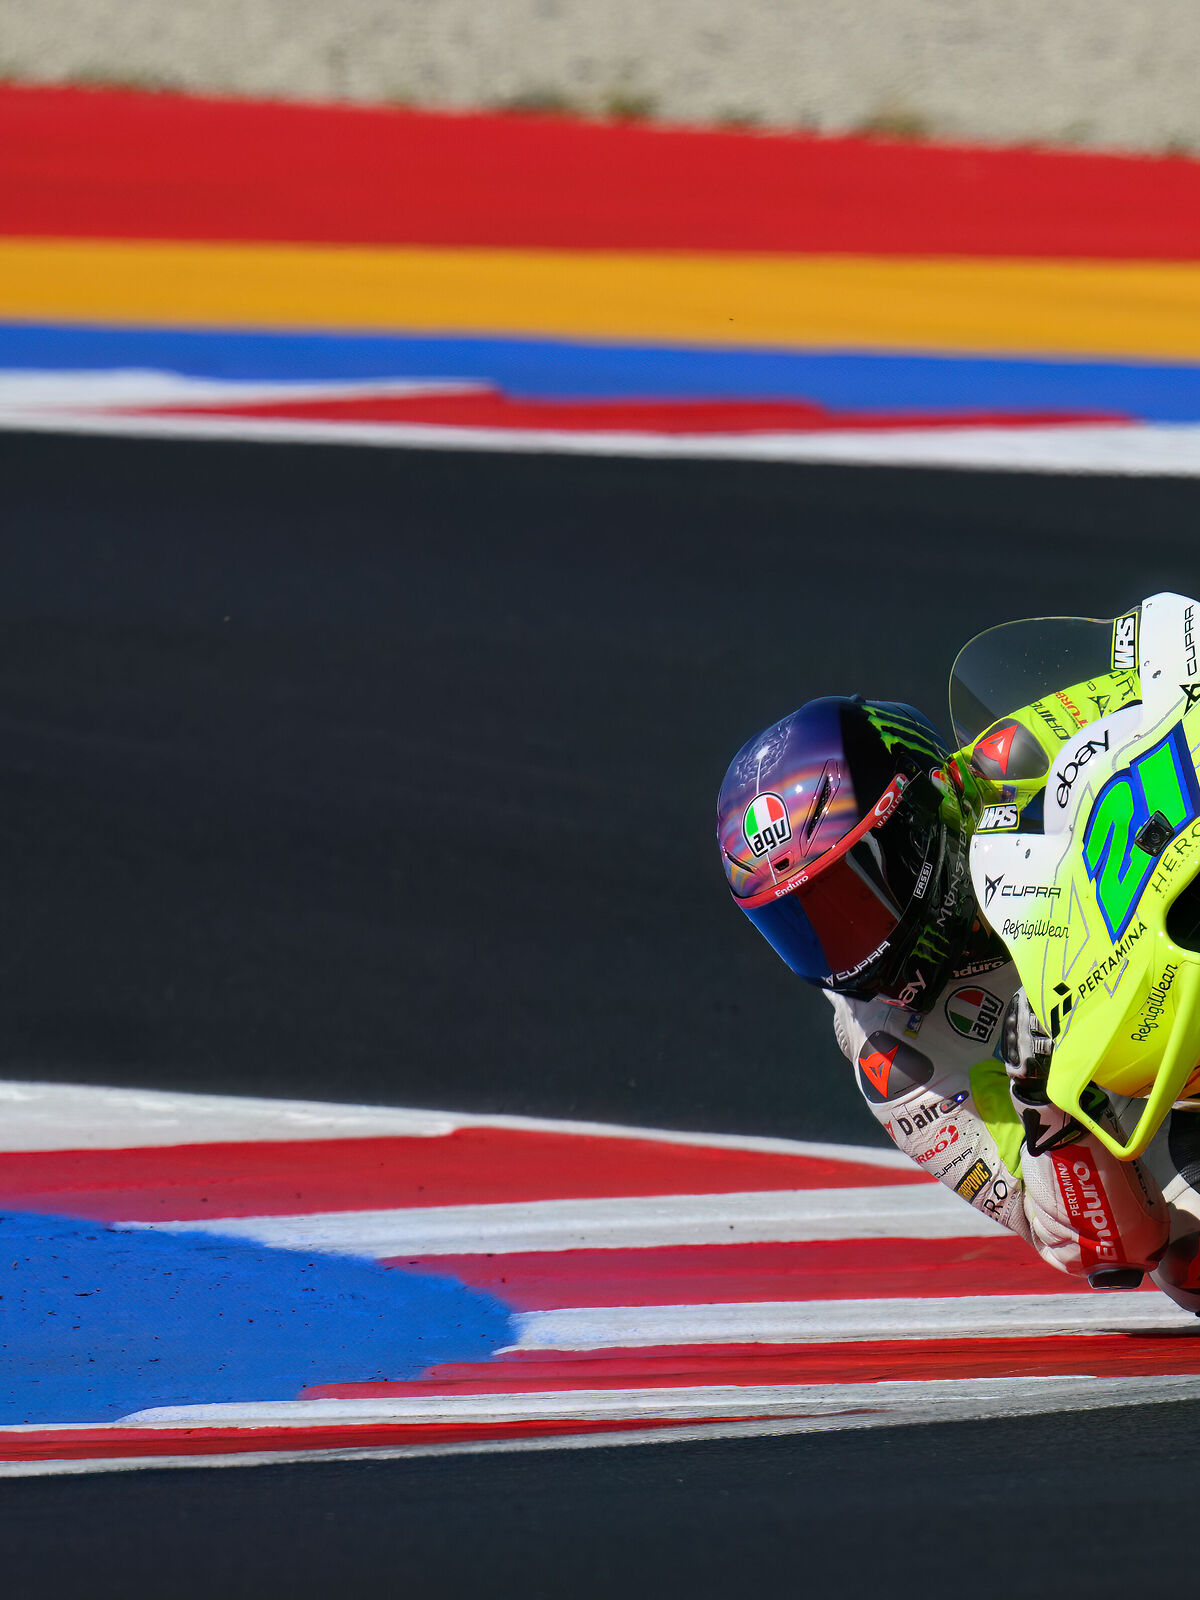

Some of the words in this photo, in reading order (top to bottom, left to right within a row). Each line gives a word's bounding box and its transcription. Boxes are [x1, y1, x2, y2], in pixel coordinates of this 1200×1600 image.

[1114, 617, 1135, 669] WRS
[1184, 605, 1198, 676] CUPRA
[1056, 730, 1109, 809] ebay
[753, 819, 785, 855] agv
[978, 806, 1017, 829] WRS
[775, 874, 809, 897] Enduro
[916, 863, 931, 896] FASSI
[1001, 885, 1061, 898] CUPRA
[1002, 918, 1070, 939] RefrigiWear
[836, 940, 891, 982] CUPRA
[1078, 921, 1148, 999] PERTAMINA
[973, 997, 999, 1039] agv
[1131, 963, 1178, 1042] RefrigiWear
[1074, 1161, 1117, 1261] Enduro
